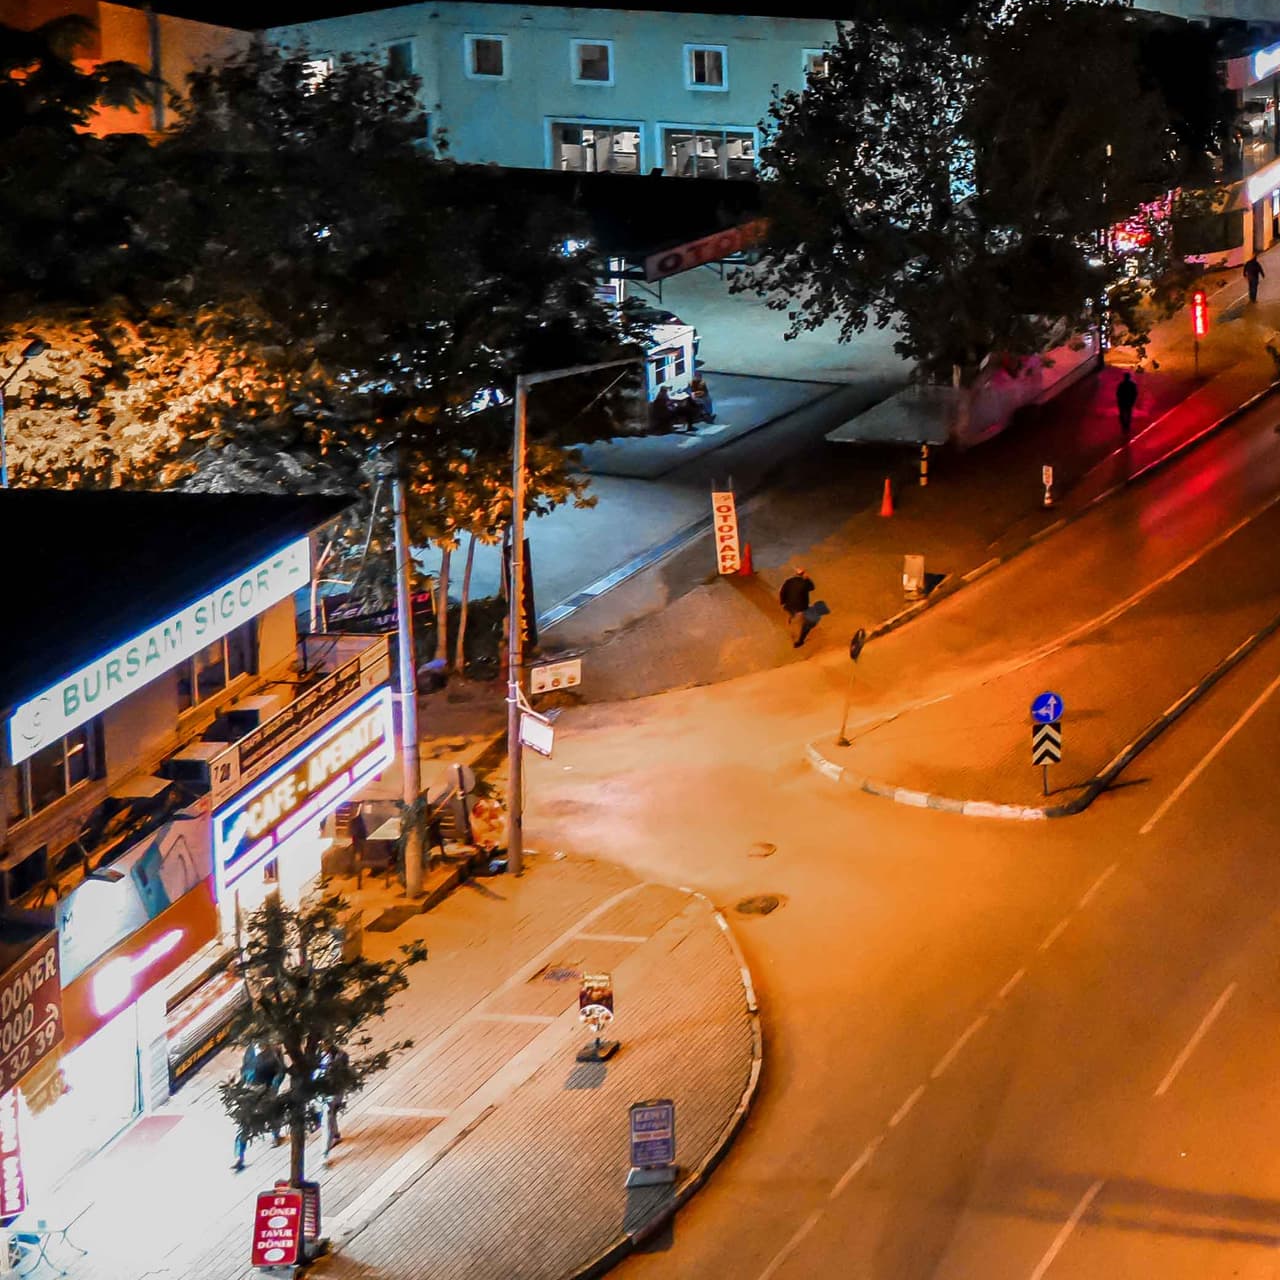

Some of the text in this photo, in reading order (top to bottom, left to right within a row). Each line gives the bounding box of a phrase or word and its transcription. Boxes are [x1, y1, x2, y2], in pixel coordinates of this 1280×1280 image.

[715, 504, 738, 573] OTOPARK
[62, 618, 184, 718] BURSAM
[1, 946, 58, 1020] DÖNER
[35, 1021, 57, 1056] 39
[260, 1206, 298, 1217] DÖNER
[256, 1238, 294, 1250] DÖNER
